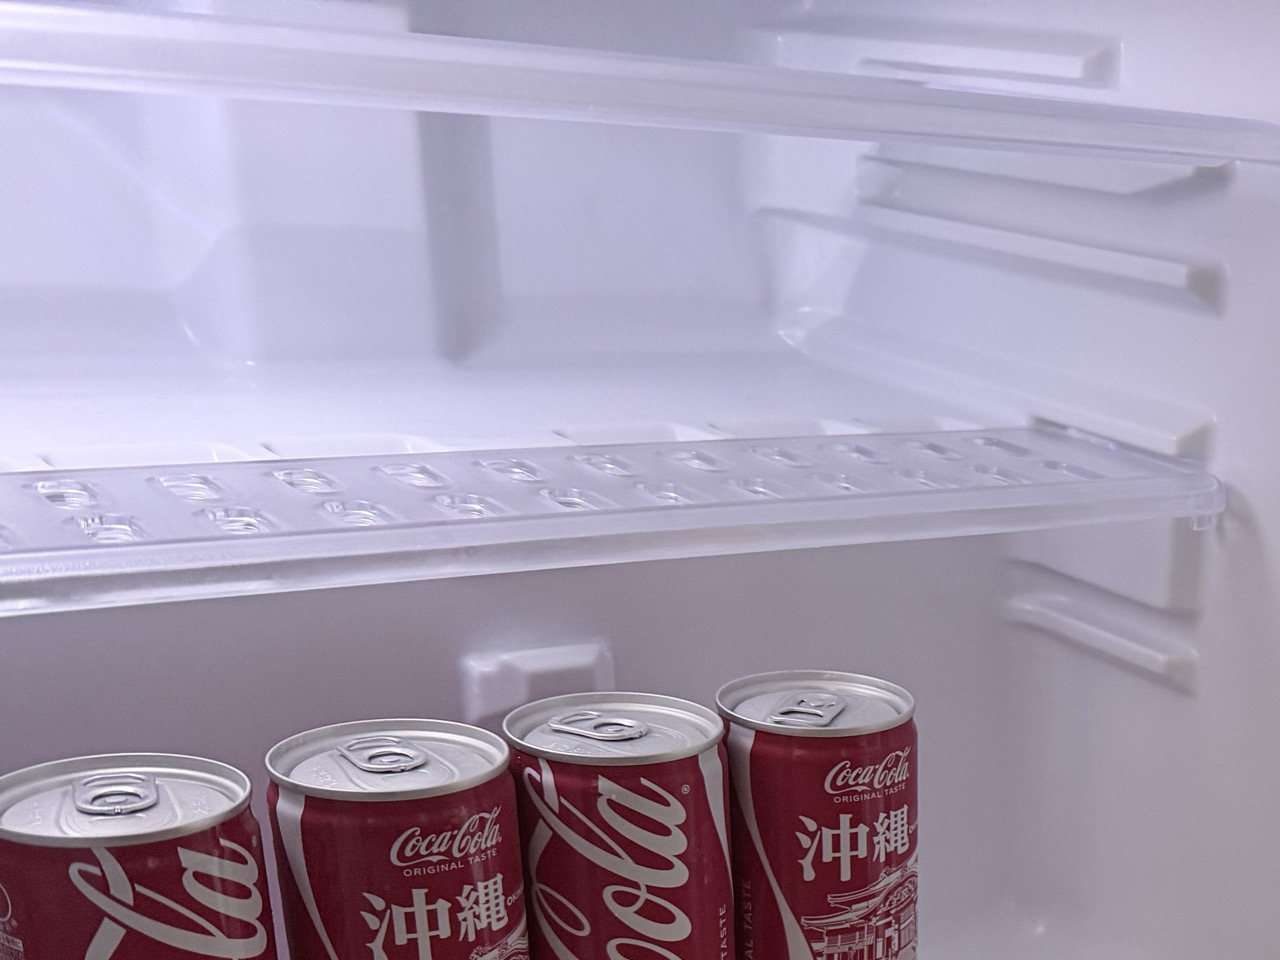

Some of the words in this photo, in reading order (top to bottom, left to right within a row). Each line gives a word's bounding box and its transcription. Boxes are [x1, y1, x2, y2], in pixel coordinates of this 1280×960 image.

[824, 746, 912, 795] Coca-Cola
[834, 791, 882, 804] ORIGINAL
[885, 783, 906, 797] TASTE
[390, 805, 502, 867] Coca-Cola
[795, 804, 910, 882] 沖縄
[403, 860, 465, 877] ORIGINAL
[467, 848, 498, 865] TASTE
[742, 880, 753, 930] TASTE
[719, 903, 728, 960] TASTE
